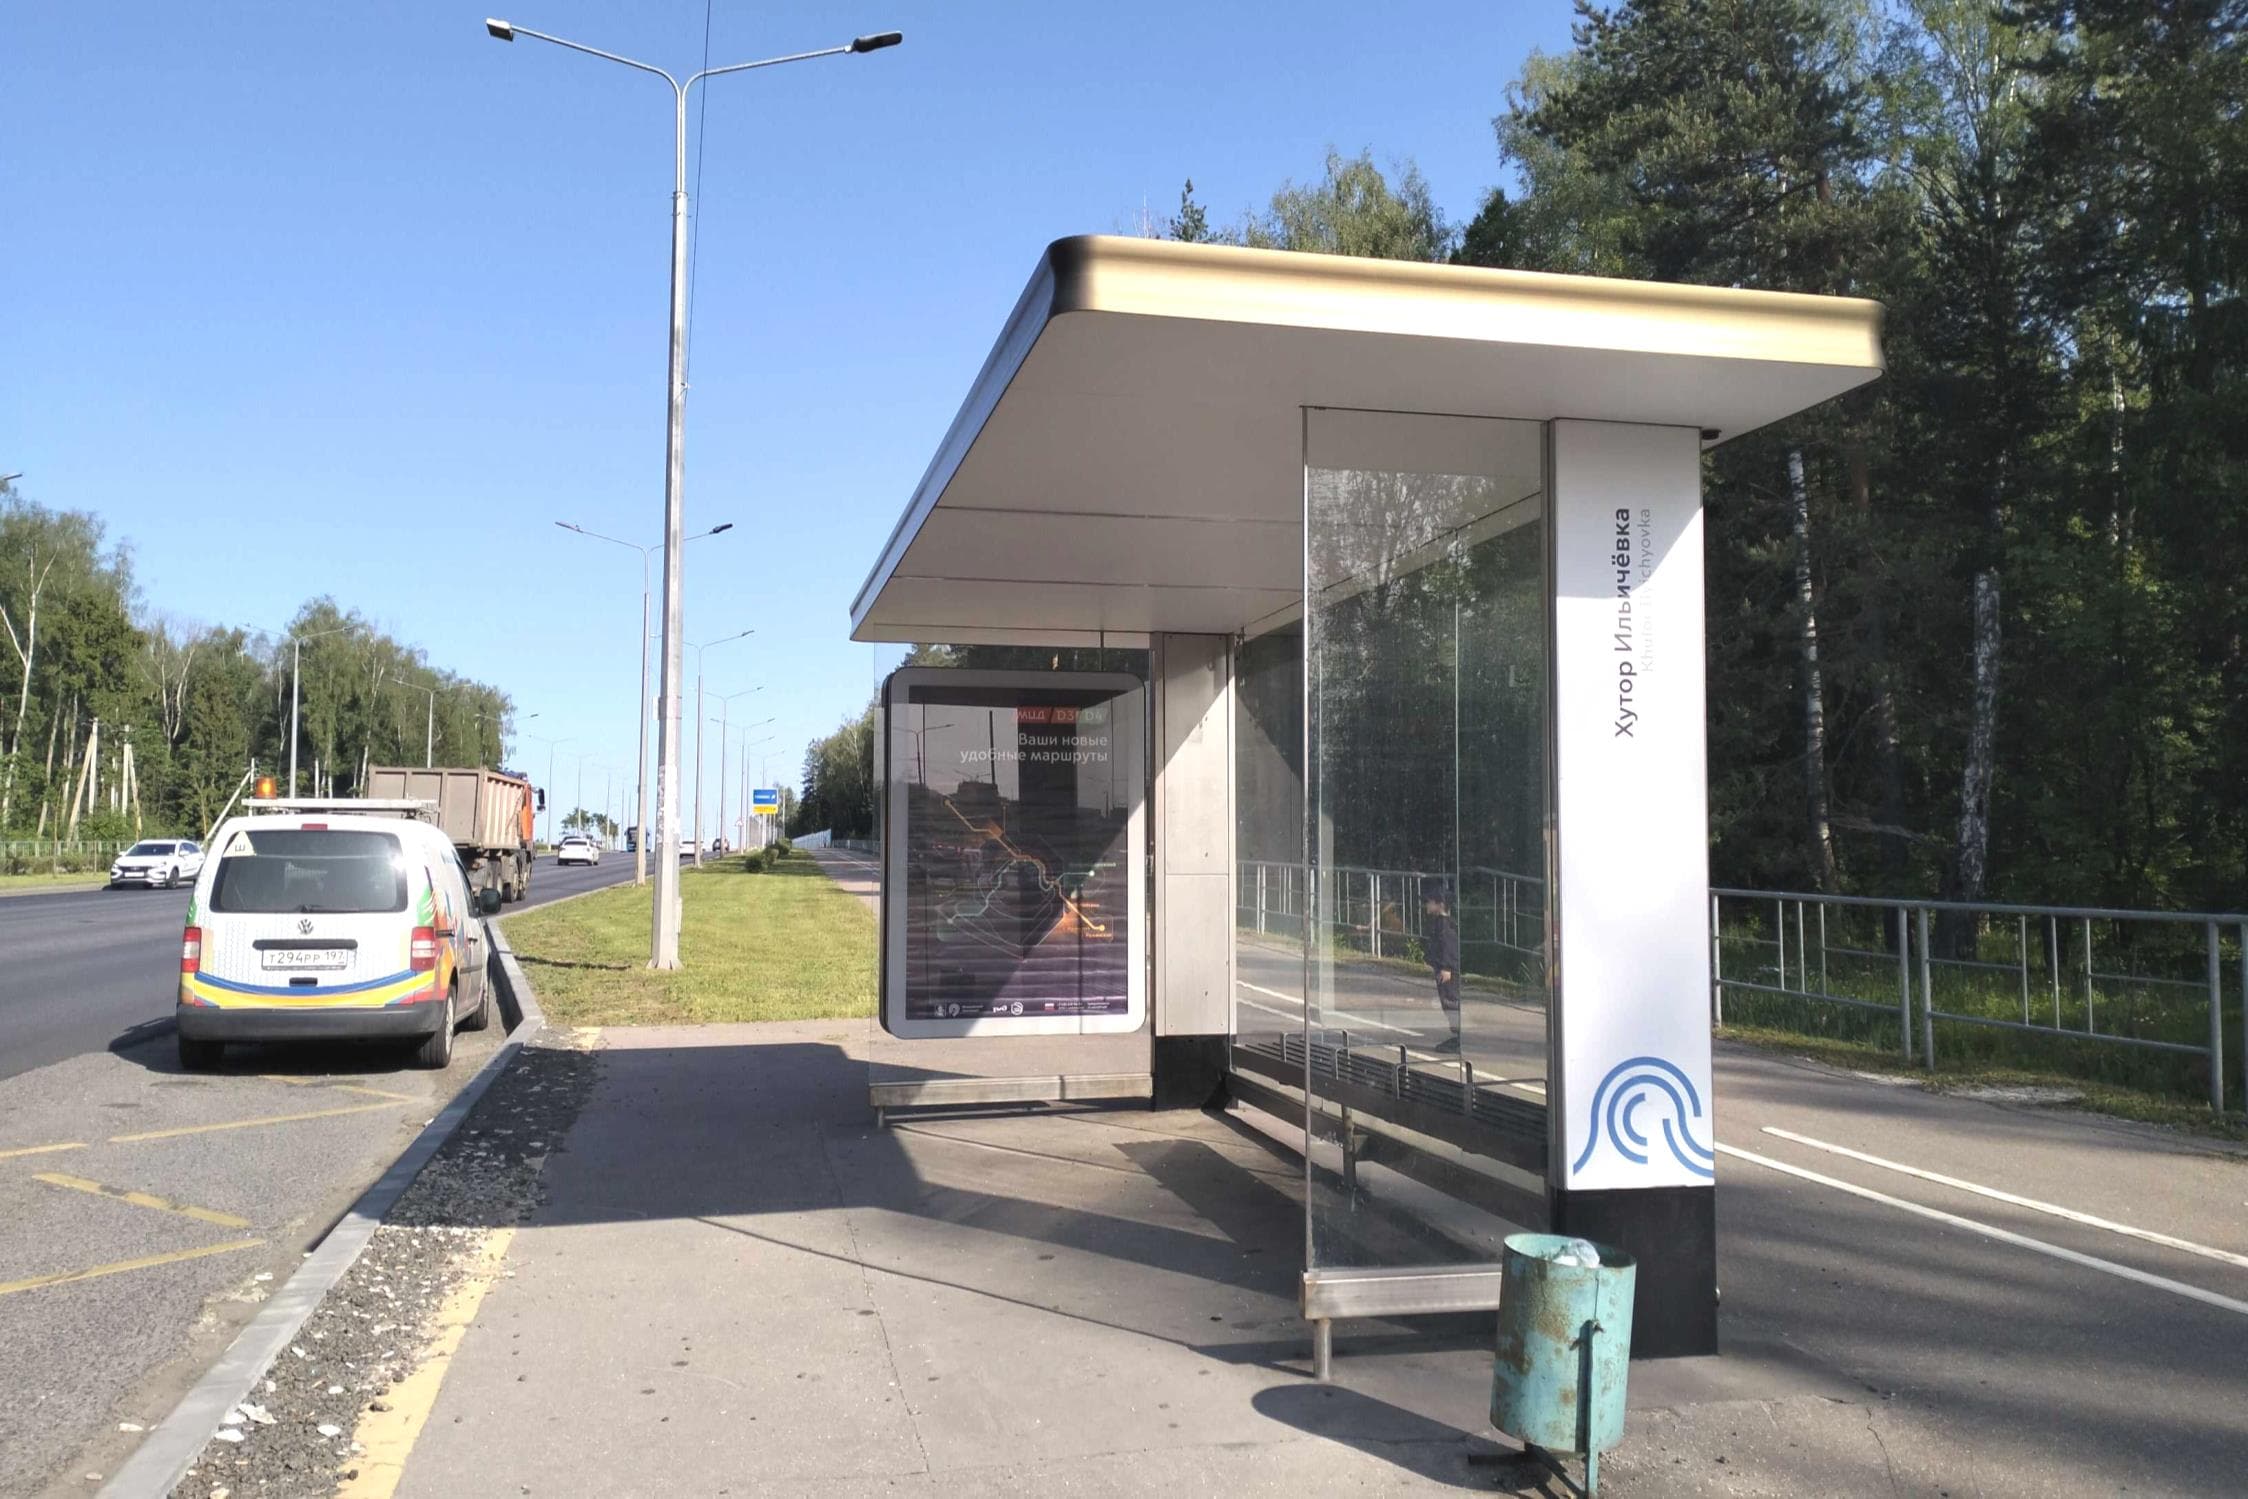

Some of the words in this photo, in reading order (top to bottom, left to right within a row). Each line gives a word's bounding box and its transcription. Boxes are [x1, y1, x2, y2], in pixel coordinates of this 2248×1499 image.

[1611, 507, 1633, 652] Ильичёвка
[1615, 660, 1638, 738] Хутор
[960, 747, 1027, 764] удобные
[1030, 750, 1108, 765] маршруты
[1018, 732, 1058, 746] Ваши
[1062, 735, 1108, 747] новые
